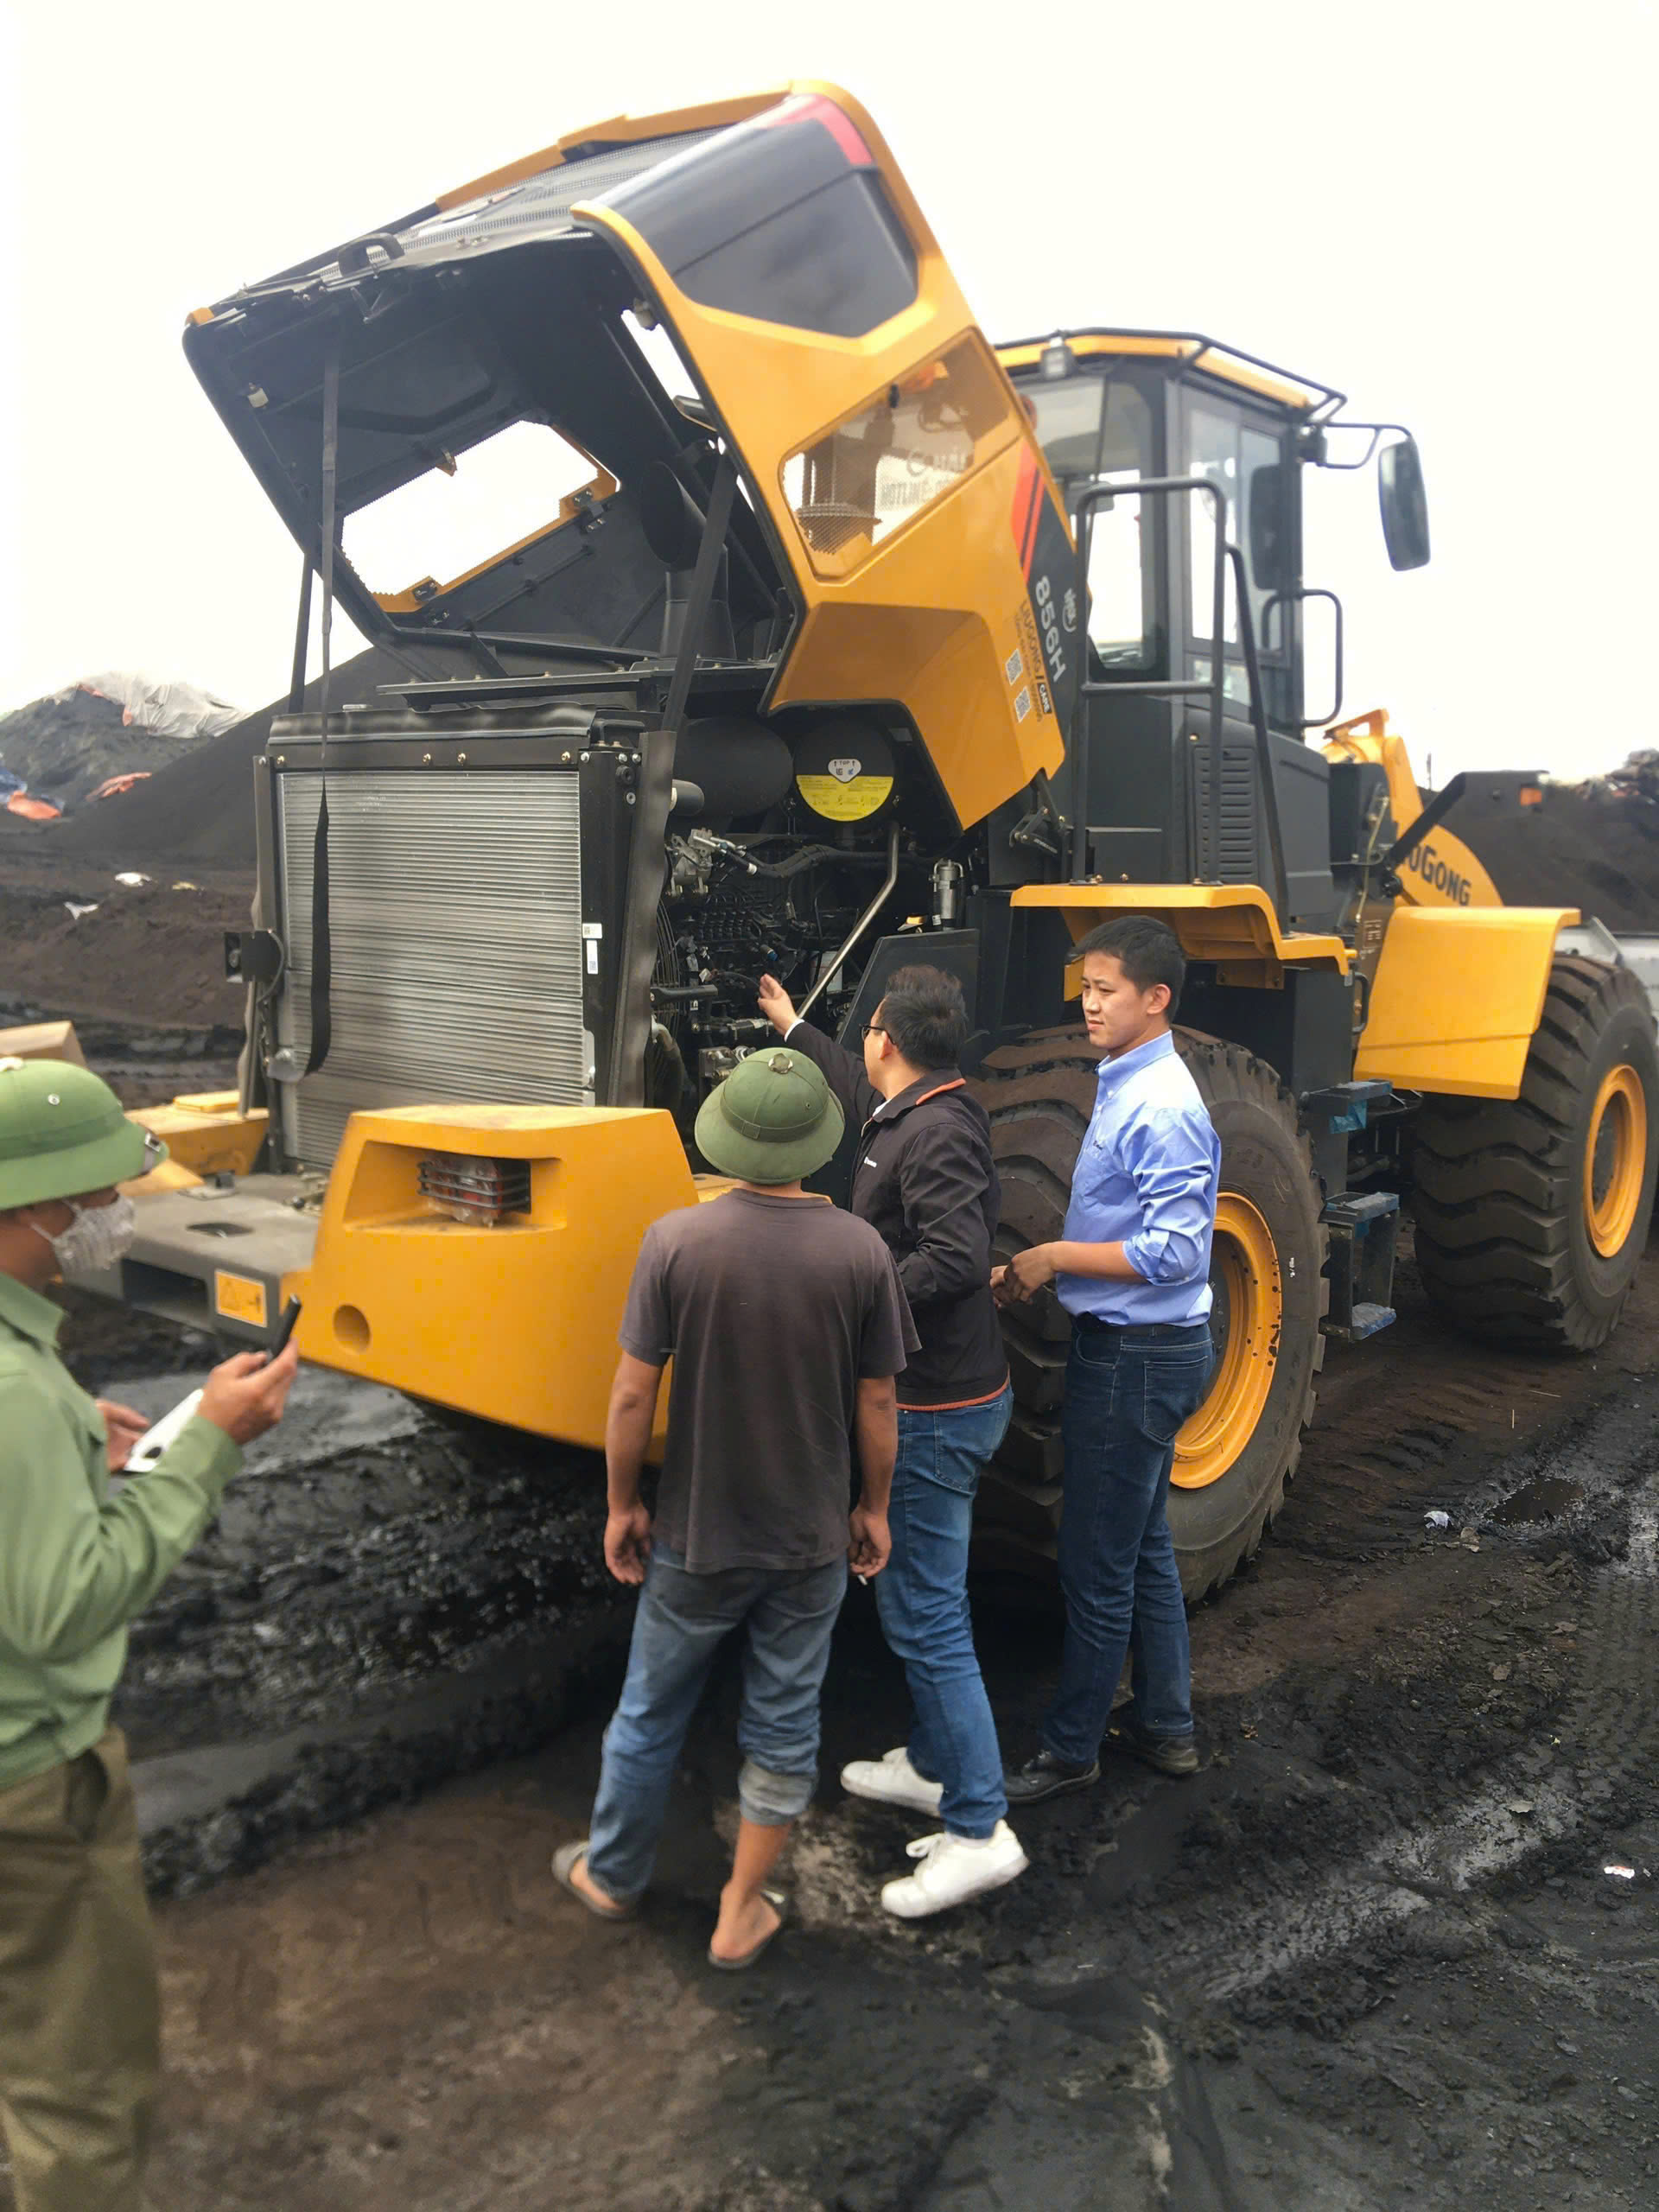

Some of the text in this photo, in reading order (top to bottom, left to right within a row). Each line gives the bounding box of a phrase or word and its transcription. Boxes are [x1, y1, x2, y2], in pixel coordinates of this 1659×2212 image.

[1020, 599, 1042, 673] LIUGONG
[1039, 683, 1052, 713] CARE
[1035, 575, 1066, 683] 856H
